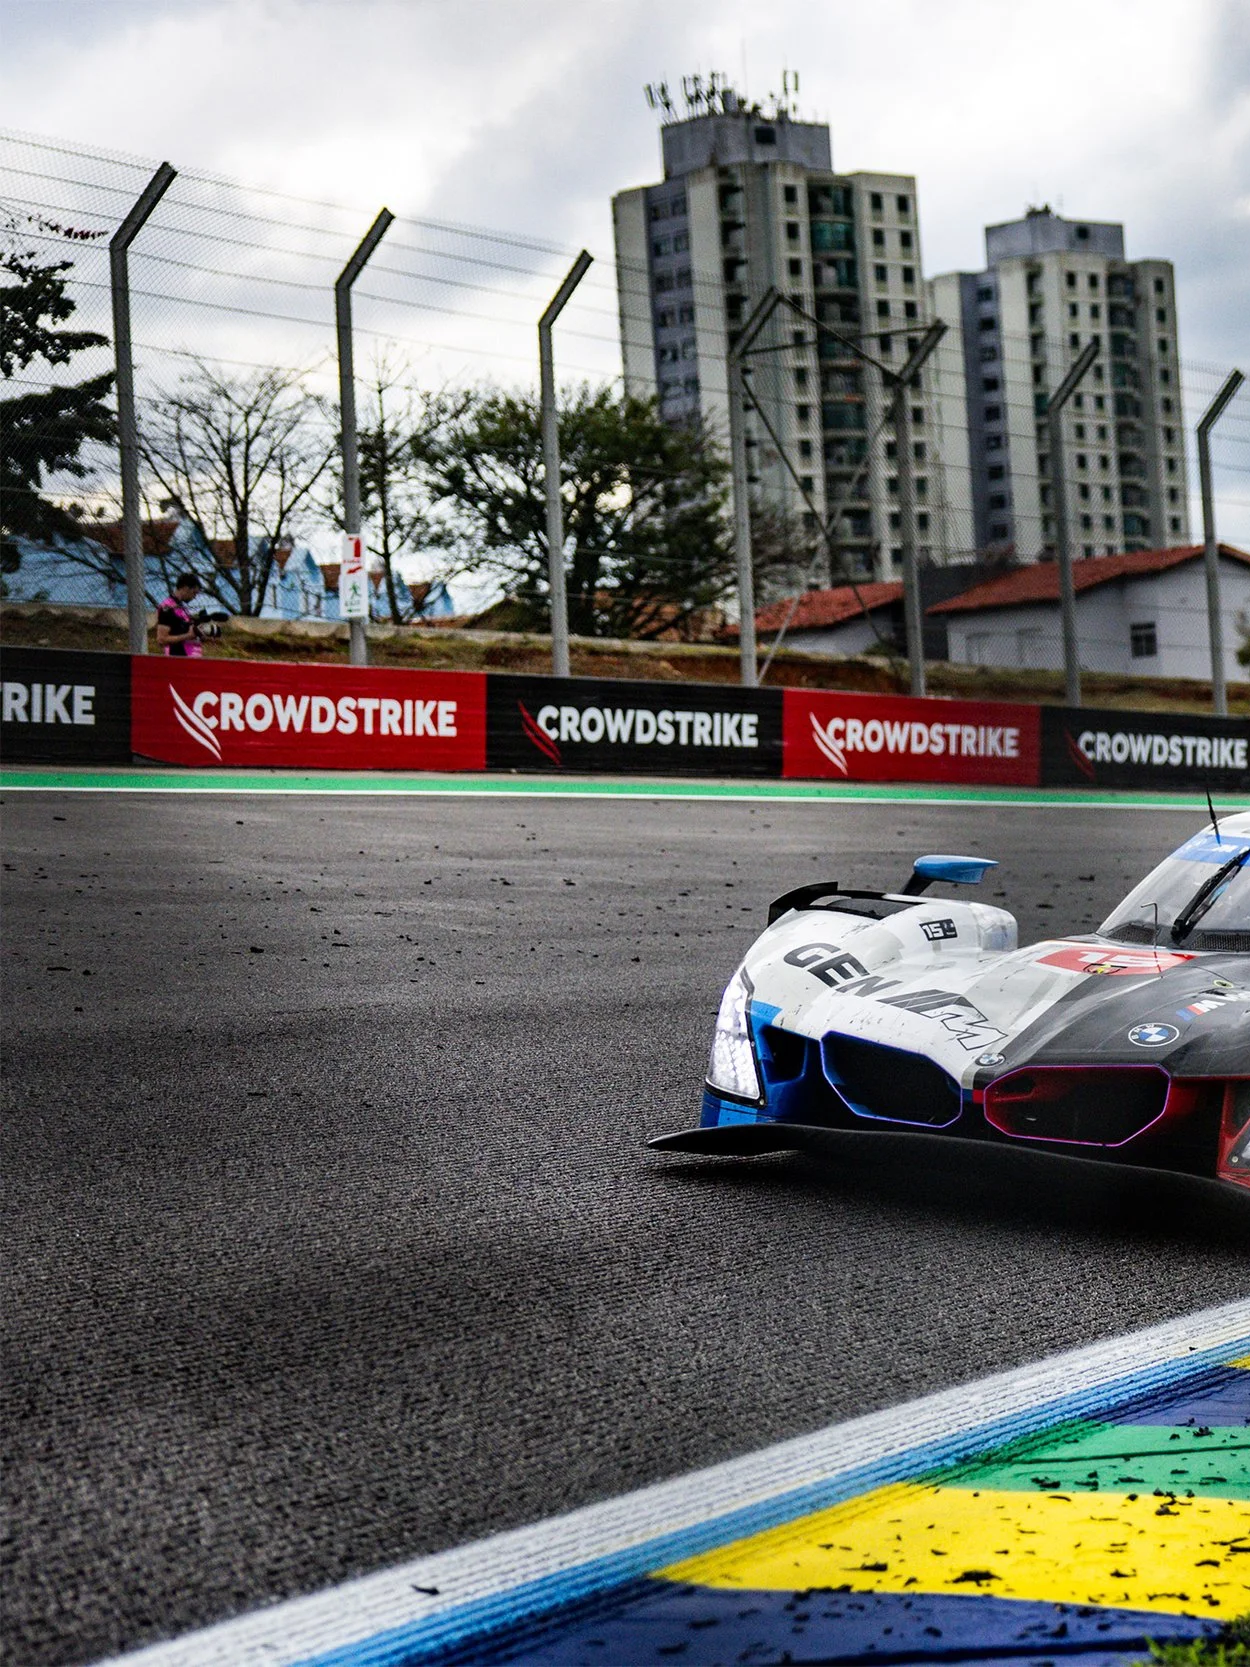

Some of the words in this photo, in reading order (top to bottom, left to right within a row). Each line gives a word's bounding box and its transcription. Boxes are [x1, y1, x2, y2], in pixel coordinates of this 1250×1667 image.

[0, 682, 96, 725] RIKE
[193, 691, 457, 737] CROWDSTRIKE
[537, 705, 759, 747] CROWDSTRIKE
[827, 717, 1020, 757] CROWDSTRIKE
[1078, 731, 1248, 769] CROWDSTRIKE
[921, 923, 944, 938] 15
[784, 942, 903, 998] GEN
